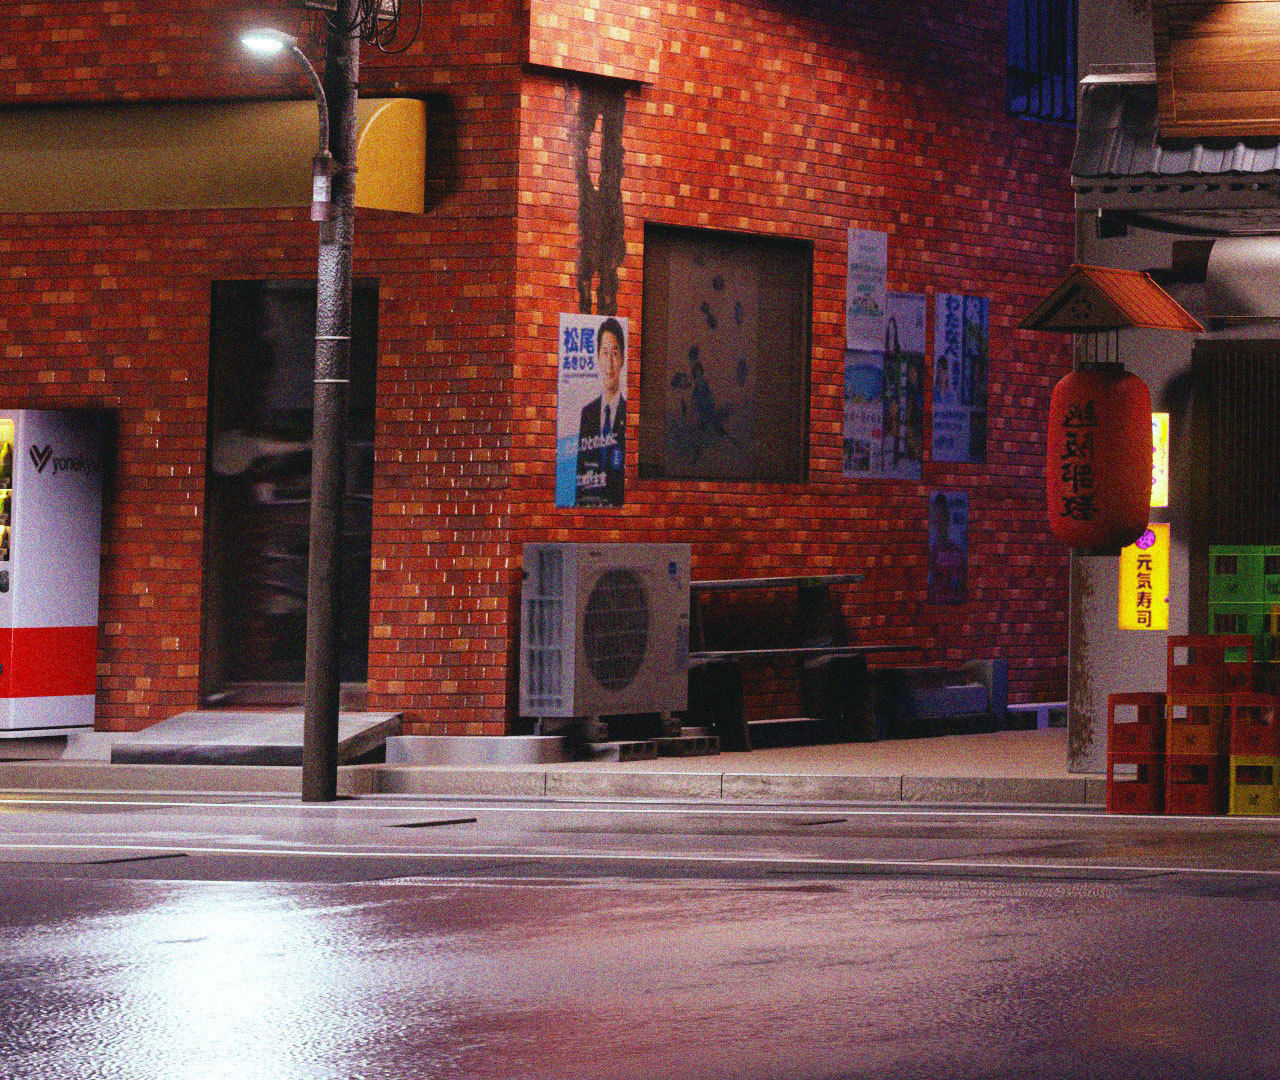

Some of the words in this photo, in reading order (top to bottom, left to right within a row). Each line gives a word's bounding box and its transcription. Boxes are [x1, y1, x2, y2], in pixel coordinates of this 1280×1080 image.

[564, 326, 595, 354] 松尾
[1136, 554, 1152, 629] 元気寿司
